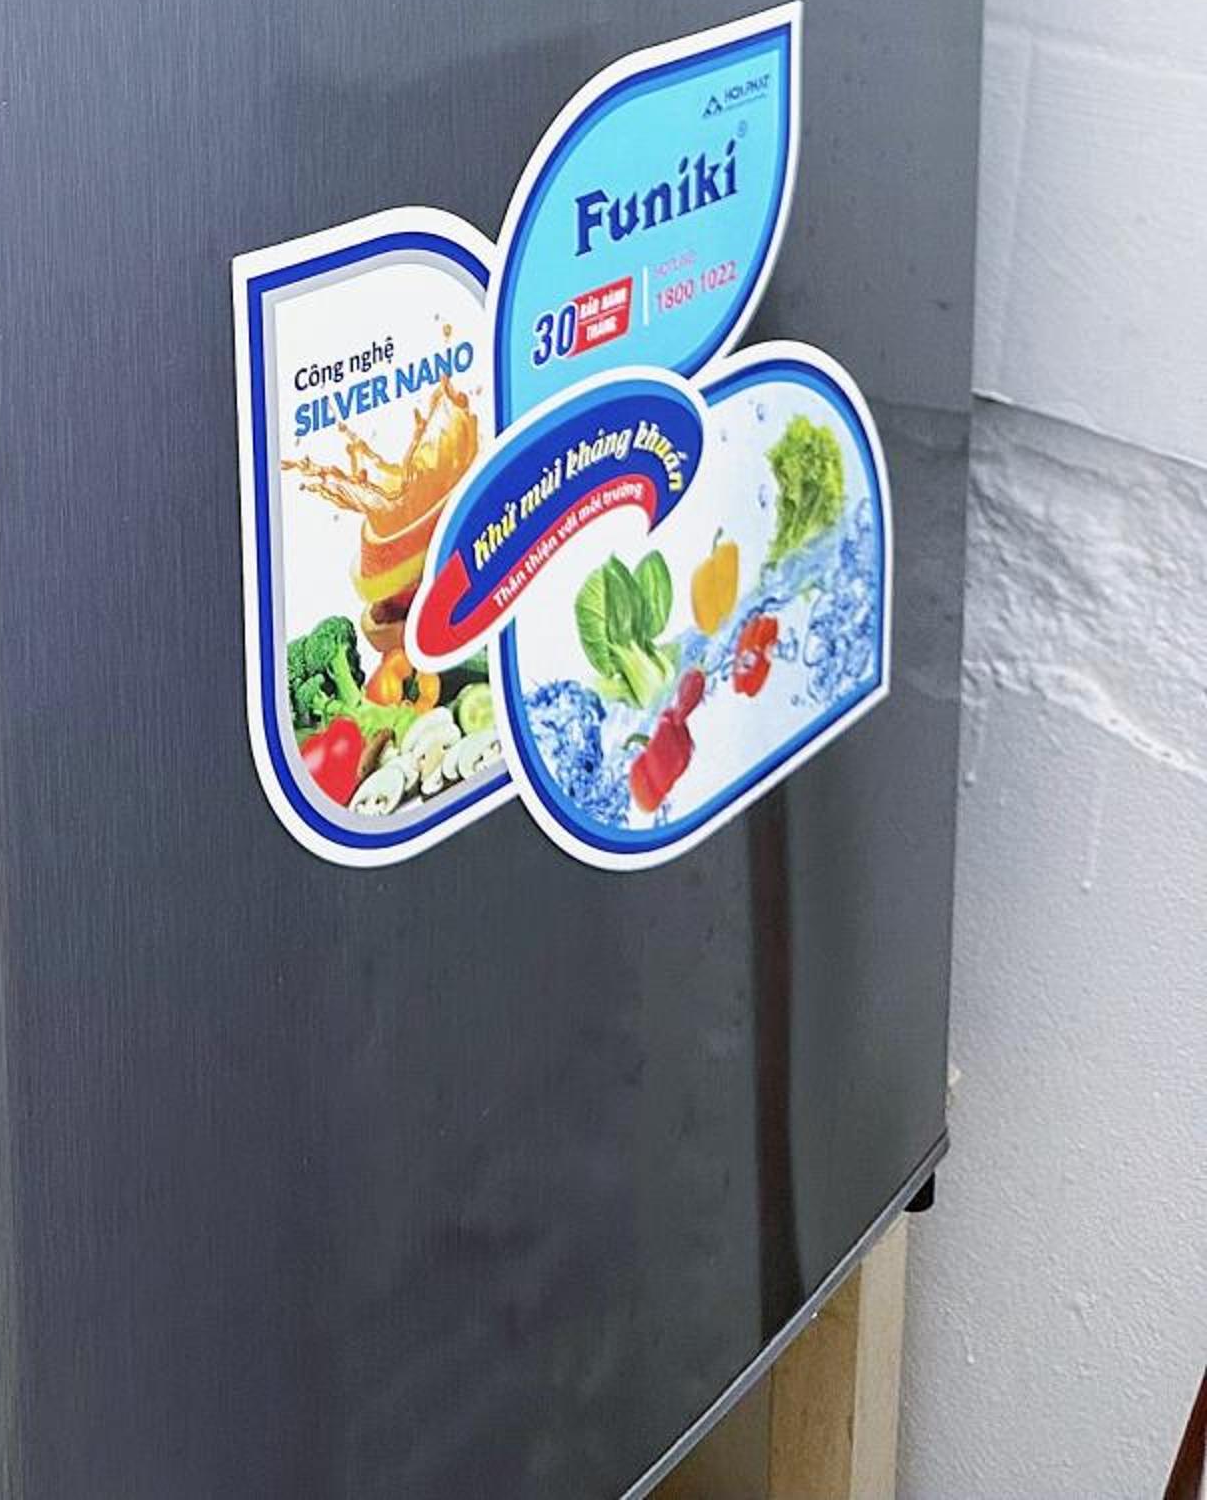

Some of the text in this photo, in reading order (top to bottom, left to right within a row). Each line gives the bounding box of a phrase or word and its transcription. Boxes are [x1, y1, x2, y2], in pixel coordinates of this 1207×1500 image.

[574, 138, 738, 257] Funiki
[657, 259, 738, 315] 1800 1022
[294, 336, 395, 392] Công nghệ
[533, 303, 578, 366] 30
[294, 341, 475, 438] SILVER NANO
[520, 457, 563, 519] mùi
